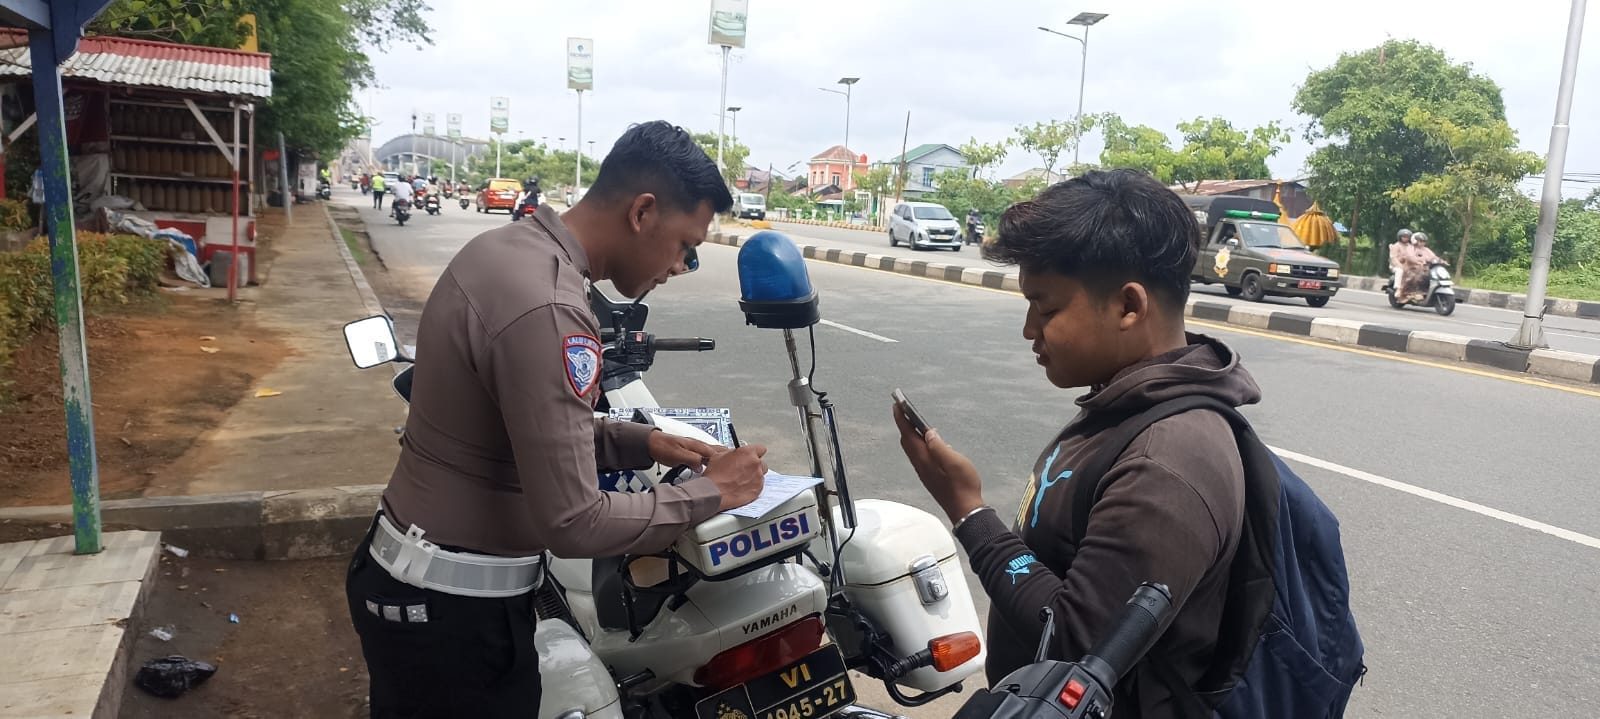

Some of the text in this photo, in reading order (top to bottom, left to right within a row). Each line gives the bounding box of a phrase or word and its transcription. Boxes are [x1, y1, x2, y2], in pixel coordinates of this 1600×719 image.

[710, 513, 809, 566] POLISI
[742, 604, 797, 634] YAMAHA
[780, 664, 811, 688] VI
